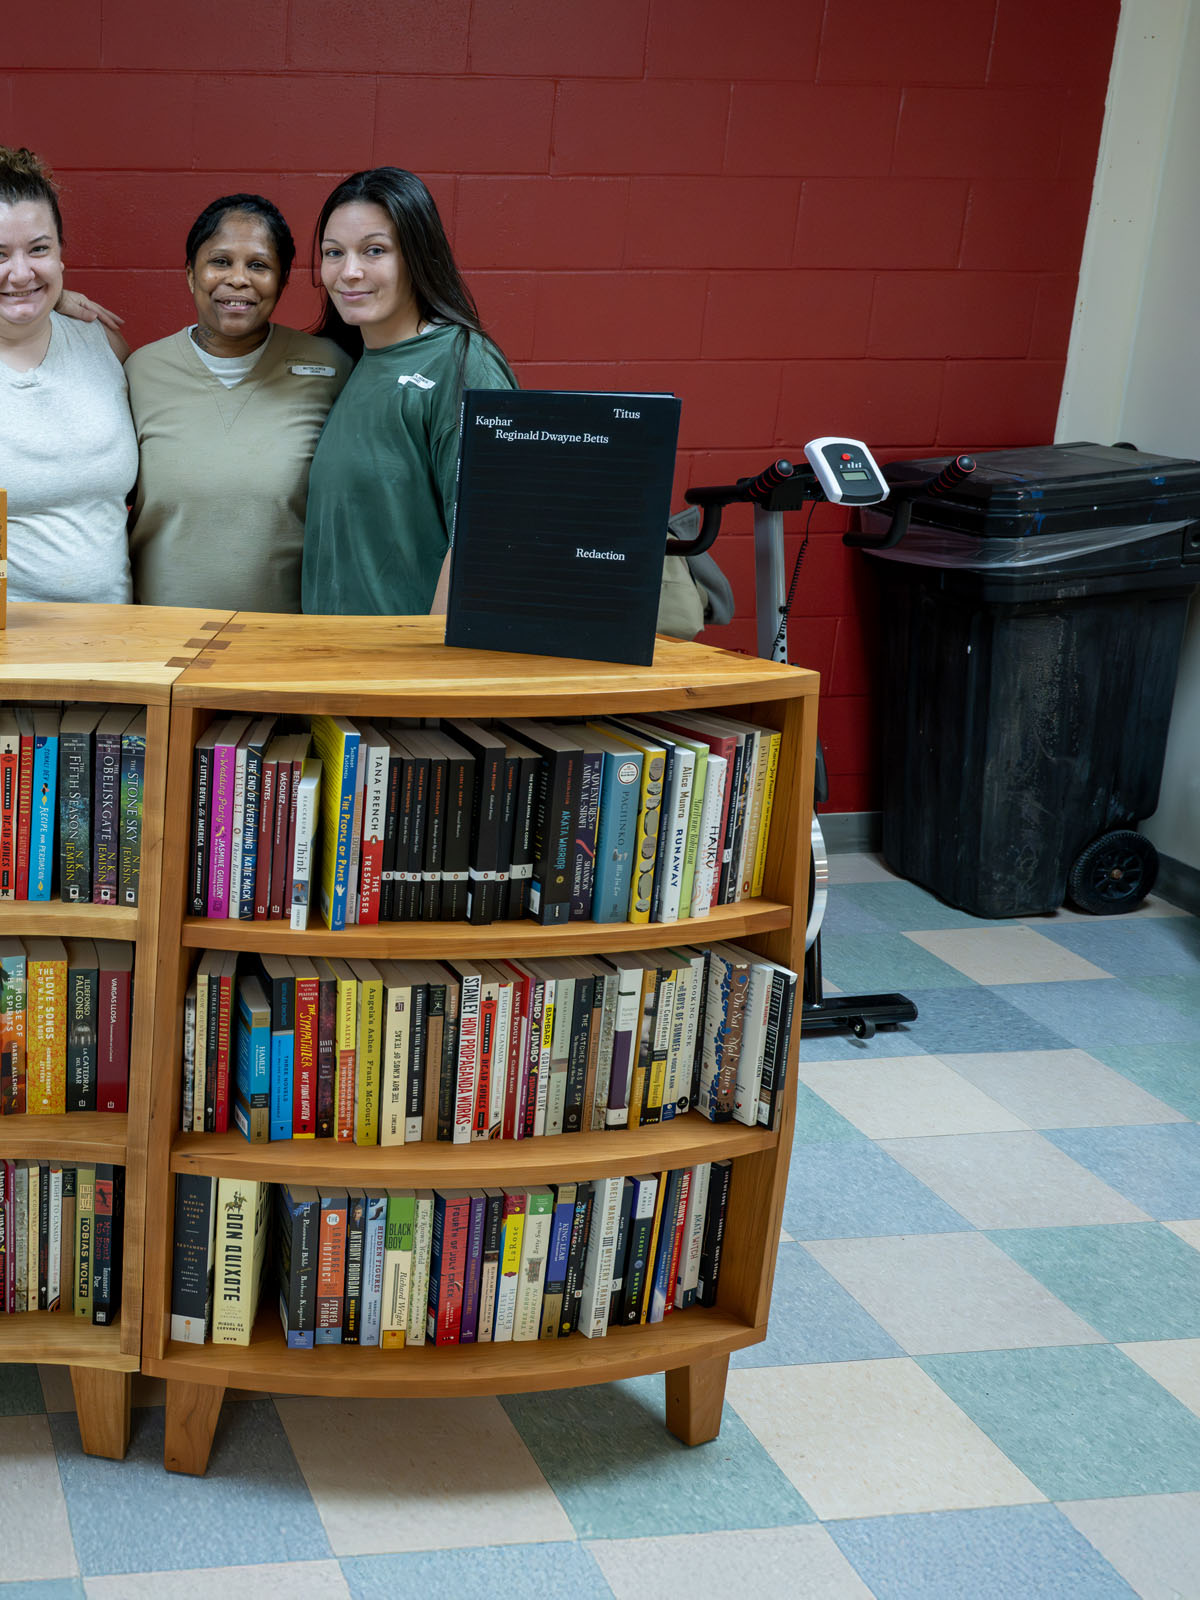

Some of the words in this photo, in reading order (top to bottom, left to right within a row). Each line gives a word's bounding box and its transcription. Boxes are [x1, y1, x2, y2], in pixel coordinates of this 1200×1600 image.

[475, 416, 513, 428] Kaphar
[613, 408, 641, 419] Titus
[495, 429, 539, 441] Reginald
[540, 431, 582, 444] Dwayne
[583, 433, 609, 444] Betts
[576, 548, 626, 561] Redaction
[69, 755, 81, 788] FIFTH
[102, 756, 114, 808] OBELISK
[373, 756, 383, 785] TANA
[681, 766, 692, 788] Alice
[126, 772, 139, 815] STONE
[342, 794, 352, 811] THE
[678, 791, 689, 819] Munro
[69, 791, 81, 840] SEASON
[101, 810, 113, 841] GATE
[370, 790, 381, 831] FRENCH
[126, 820, 138, 844] SKY
[339, 814, 350, 843] PEOPLE
[296, 842, 308, 873] Think
[337, 859, 347, 882] PAPER
[670, 829, 684, 888] RUNAWAY
[361, 855, 372, 914] TRESPASSER
[371, 875, 380, 893] THE
[75, 975, 84, 1020] FALCONES
[463, 978, 480, 1015] STANLEY
[664, 982, 675, 1008] Kitchen
[299, 1014, 313, 1068] SYMPATHIZER
[461, 1017, 478, 1038] HOW
[660, 1009, 672, 1050] Confidential
[458, 1039, 476, 1095] PROPAGANDA
[456, 1096, 472, 1125] WORKS
[81, 1218, 90, 1257] TOBIAS
[226, 1214, 244, 1241] DON
[389, 1223, 411, 1236] BLACK
[349, 1230, 363, 1261] ANTHONY
[389, 1237, 402, 1249] BOY
[80, 1262, 89, 1297] WOLFF
[224, 1245, 242, 1302] QUIXOTE
[347, 1263, 360, 1297] BOURDAIN
[374, 1259, 383, 1293] FIGURES
[399, 1272, 407, 1299] Richard
[396, 1301, 406, 1327] Wright
